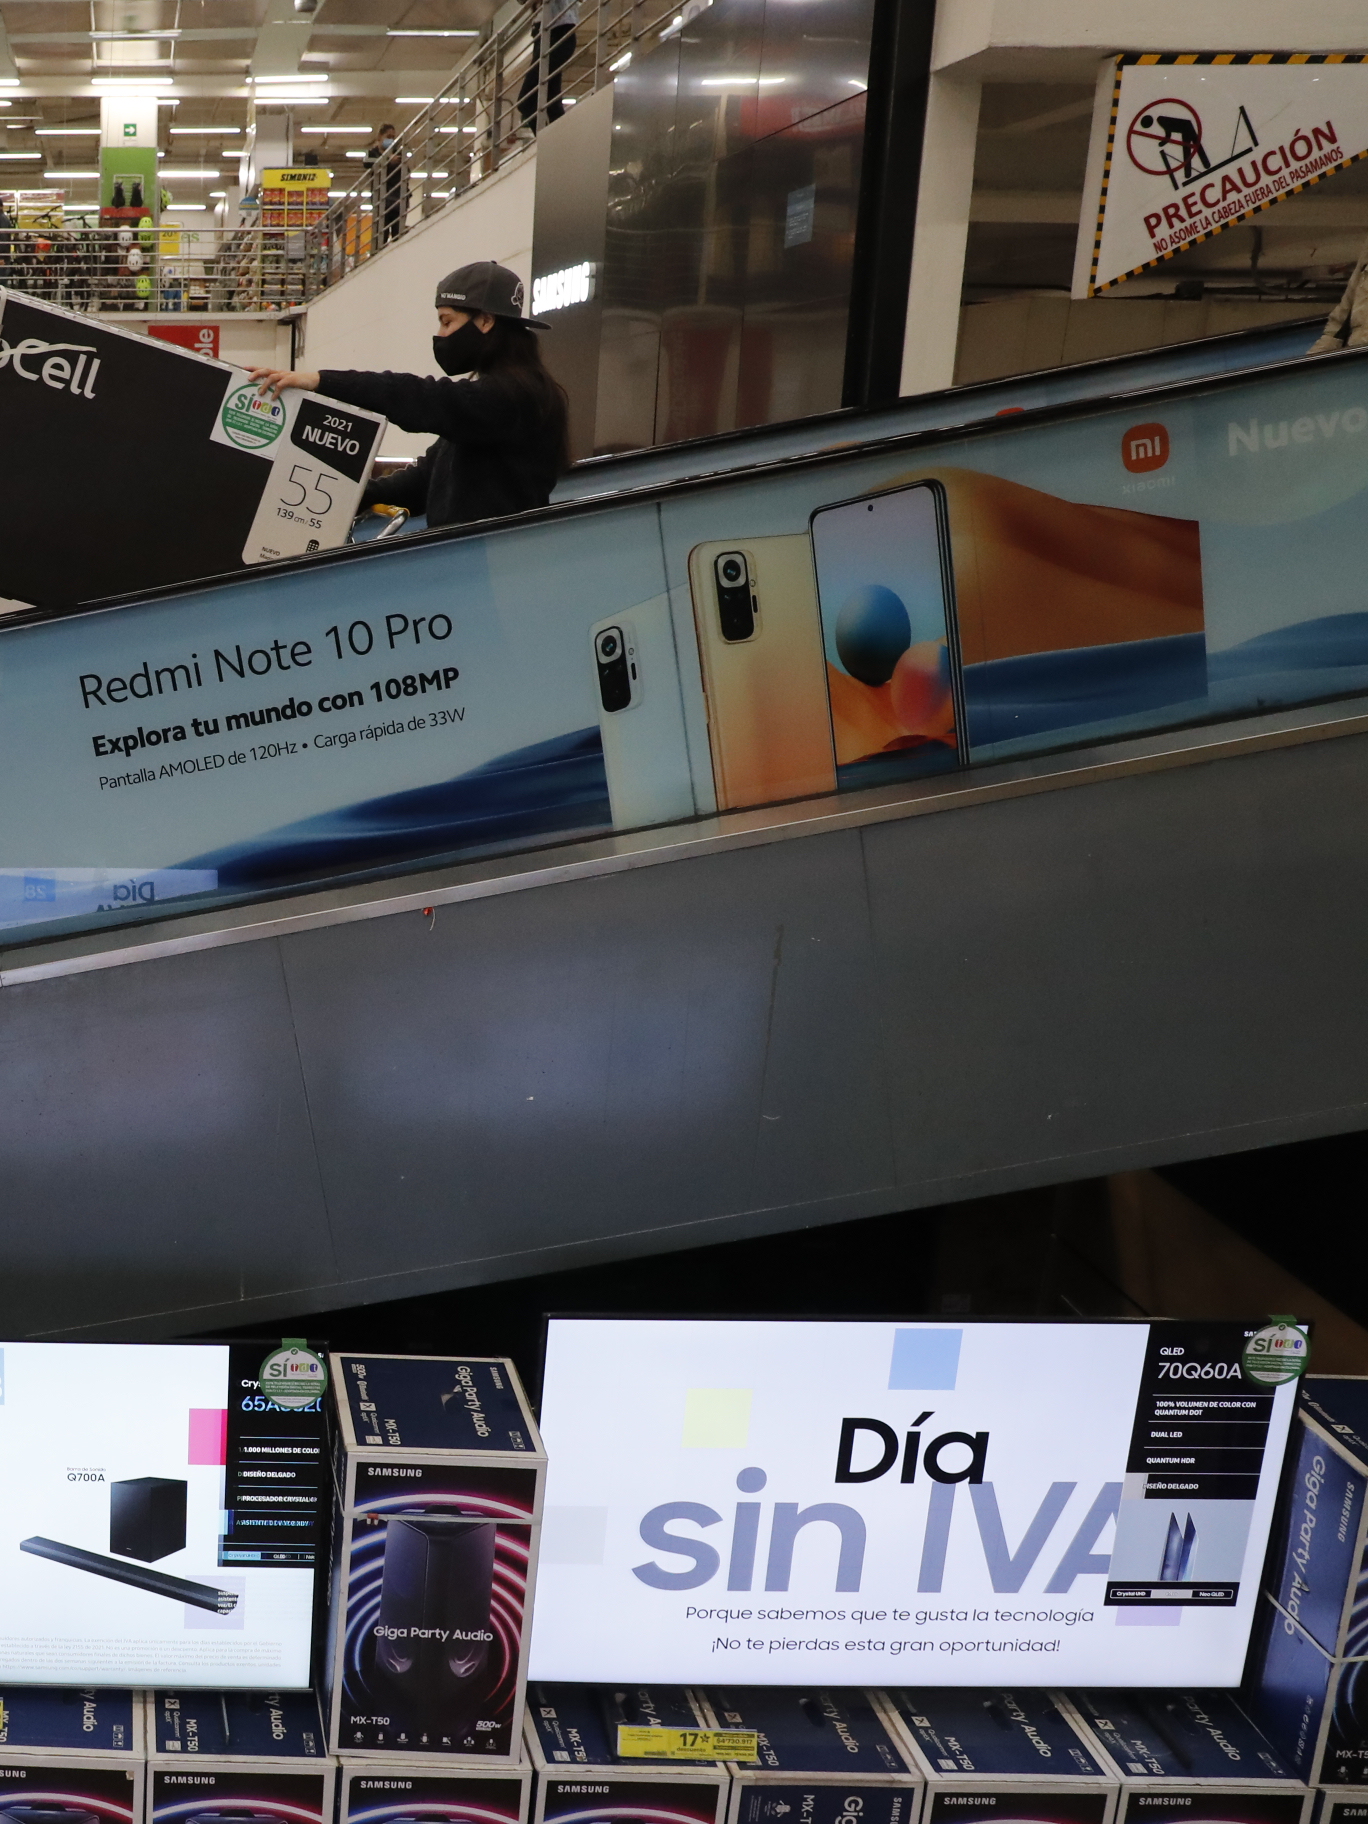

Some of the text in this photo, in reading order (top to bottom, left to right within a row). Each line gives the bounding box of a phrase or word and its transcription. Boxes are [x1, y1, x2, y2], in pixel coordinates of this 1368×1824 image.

[280, 173, 318, 182] SIMONIZ
[1143, 120, 1338, 239] PRECAUCIÓN
[1153, 146, 1344, 254] NO ASOME LA CABEZA FUERA DEL PASAMANOS
[533, 261, 595, 312] SAMSUNG
[323, 414, 353, 433] 2021
[1227, 406, 1367, 457] Nuevo
[301, 425, 360, 455] NUEVO
[280, 464, 338, 515] 55
[276, 507, 295, 520] 139
[294, 515, 306, 525] cm
[79, 612, 453, 709] Redmi Note 10 Pro
[92, 667, 461, 757] Explora tu mundo con 108MP
[98, 707, 466, 791] Pantalla AMOLED de 120Hz Carga rápida de 33W
[1160, 1347, 1185, 1356] QLED
[1157, 1362, 1242, 1380] 70Q60A
[834, 1411, 990, 1485] Día
[67, 1472, 106, 1483] Q700A
[367, 1467, 423, 1478] SAMSUNG
[631, 1466, 1124, 1594] sin IVA
[685, 1604, 1095, 1626] Porque sabemos que te gusta la tecnología
[373, 1624, 494, 1645] Giga Party Audio
[711, 1636, 1062, 1657] ¡No te pierdas esta gran oportunidad!
[679, 1732, 699, 1747] 17
